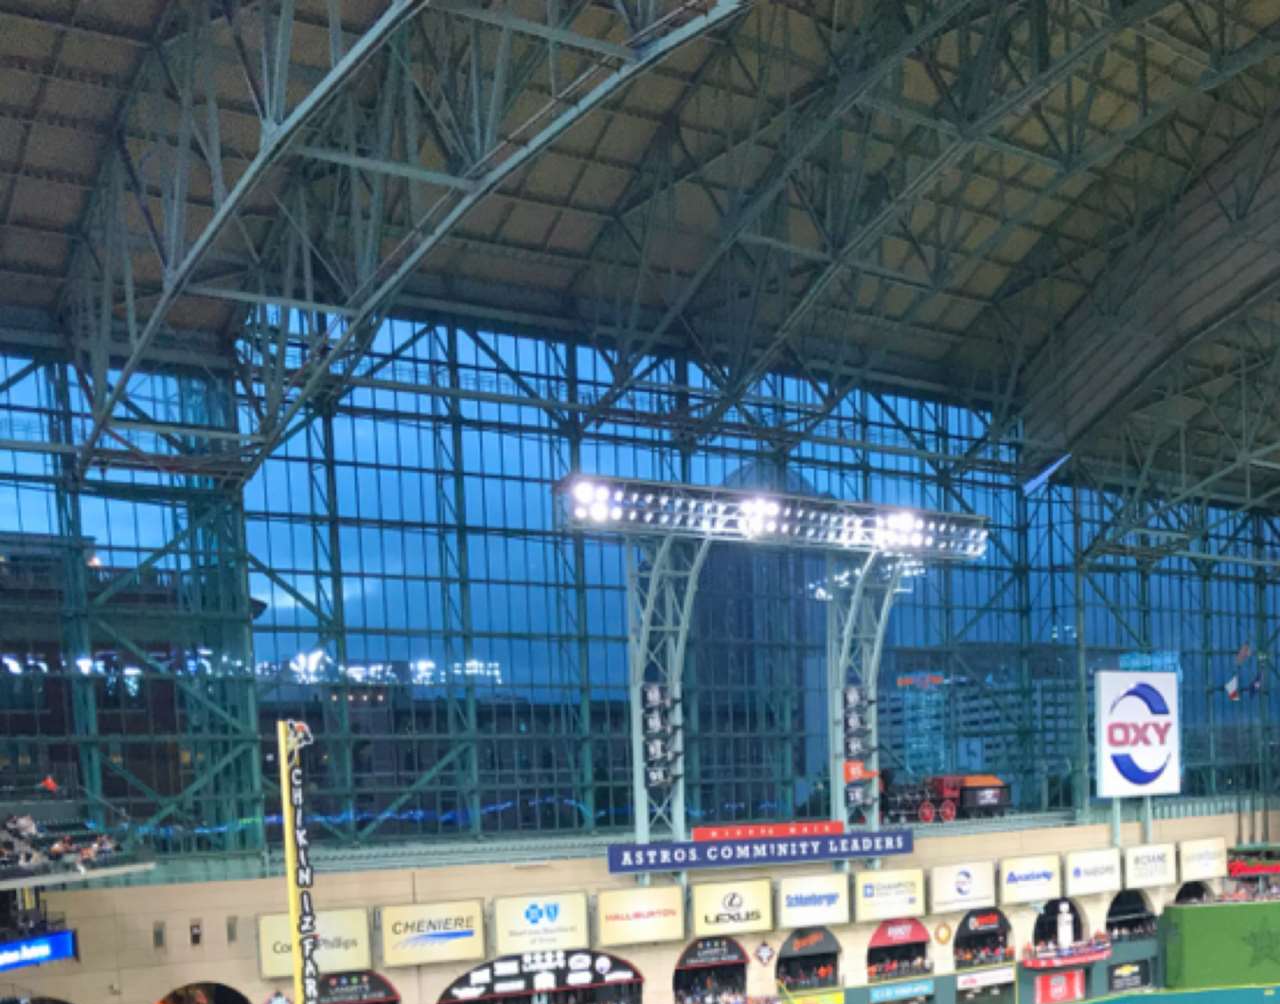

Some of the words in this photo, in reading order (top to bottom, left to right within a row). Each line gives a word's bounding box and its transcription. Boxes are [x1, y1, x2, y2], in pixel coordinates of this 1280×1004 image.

[1107, 721, 1172, 747] OXY
[291, 768, 311, 886] CHIKIN
[621, 847, 697, 867] ASTROS
[829, 836, 904, 854] LEADERS
[391, 915, 475, 936] CHENIERE
[704, 910, 762, 925] LEXUS
